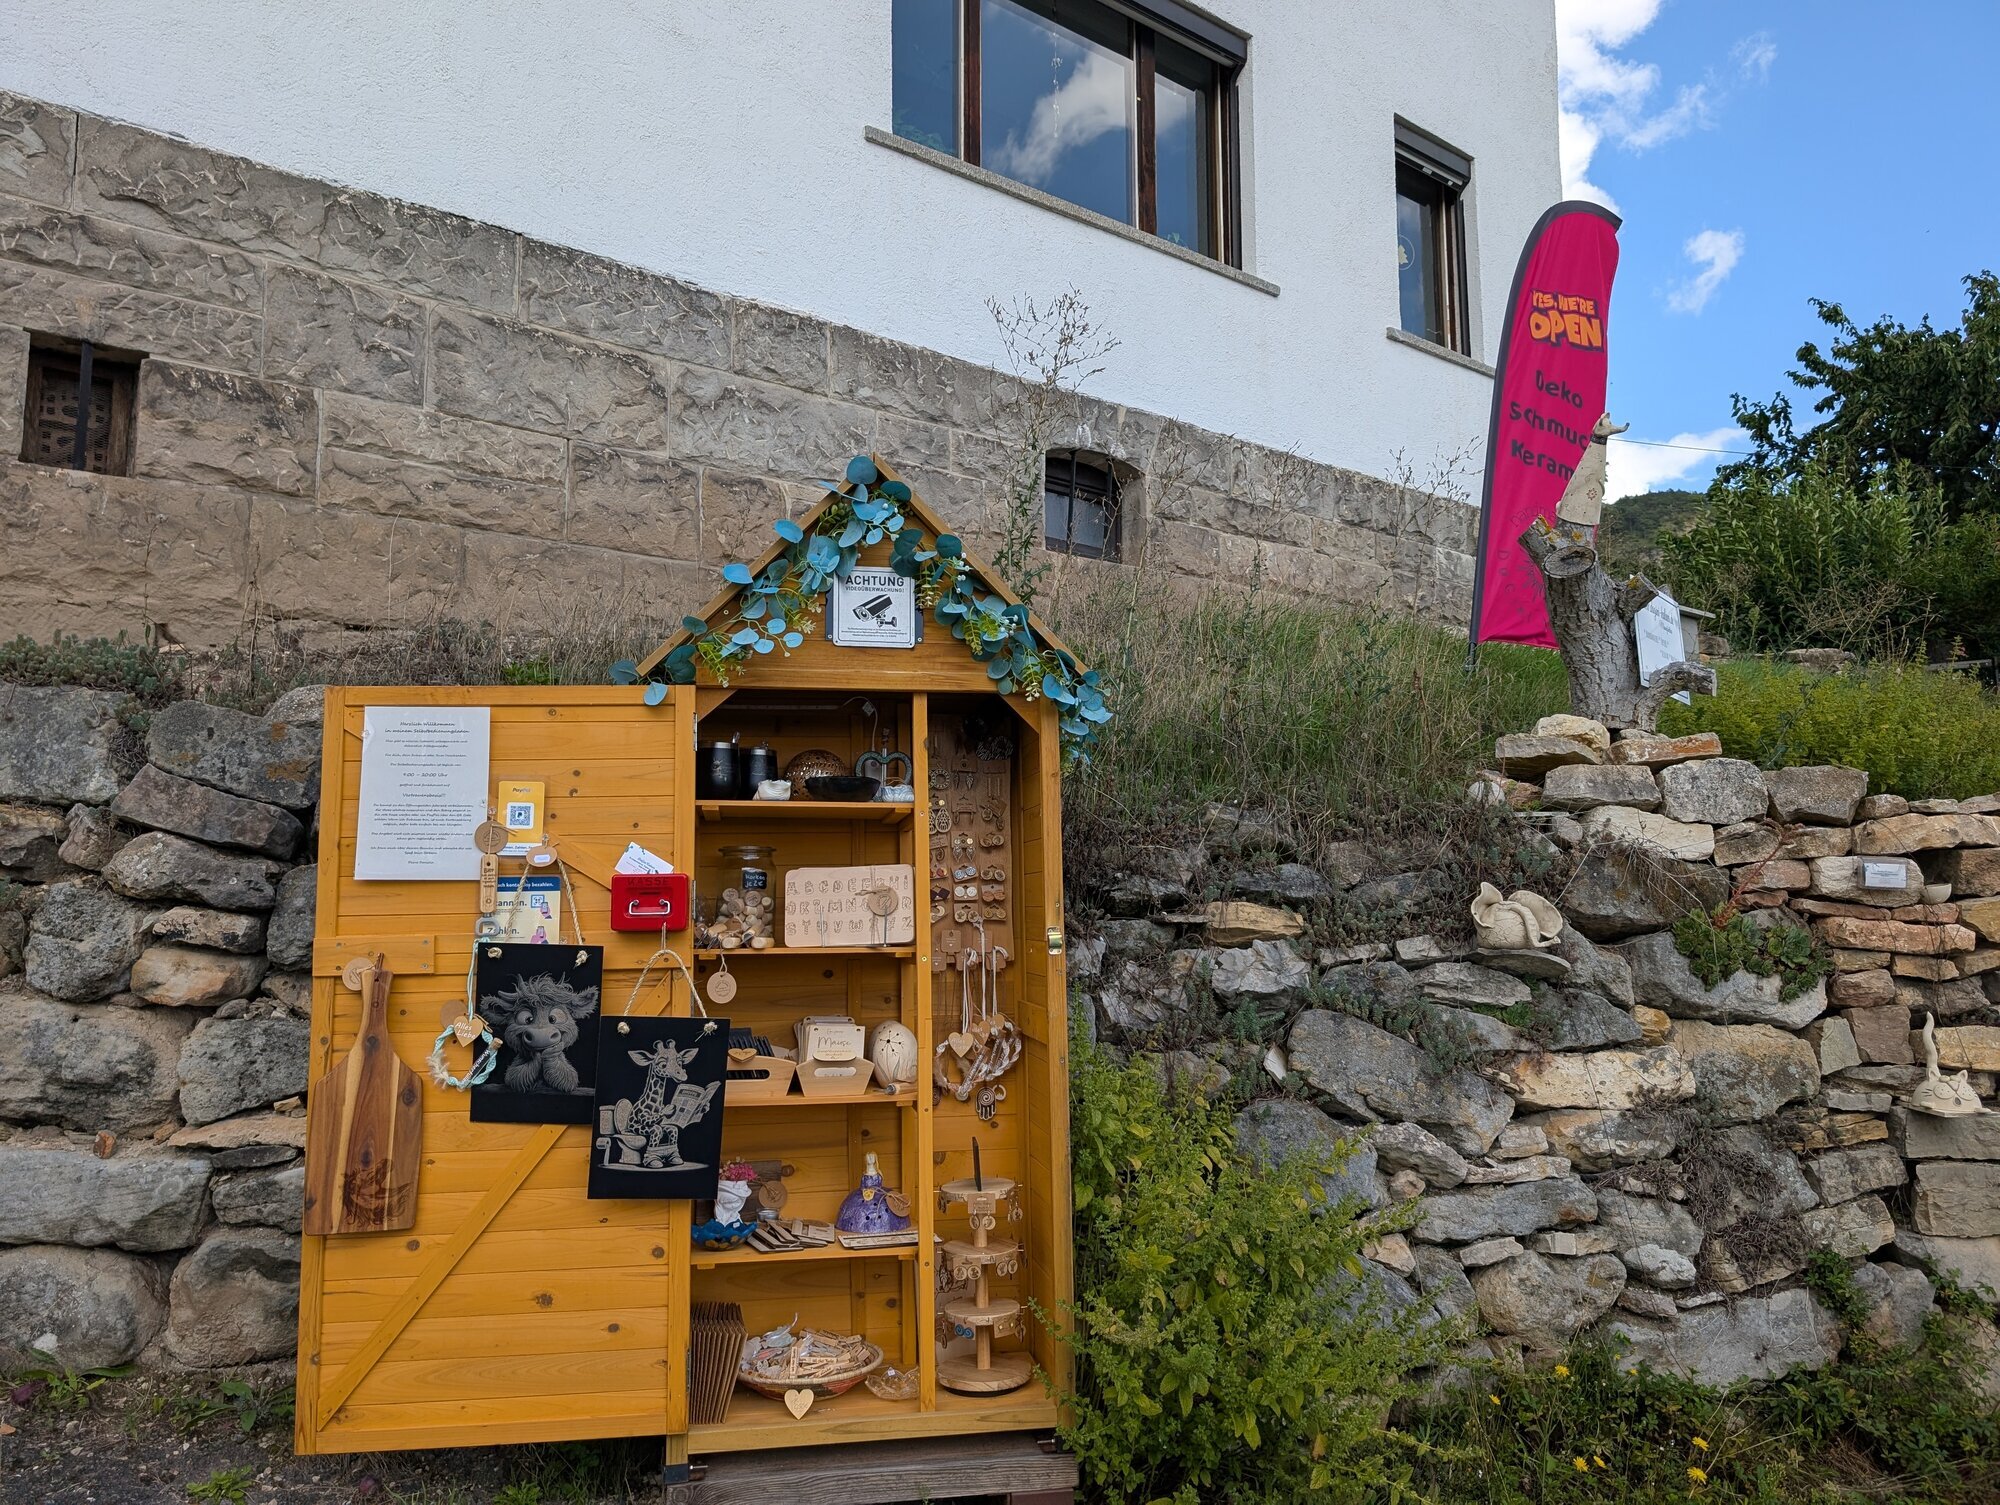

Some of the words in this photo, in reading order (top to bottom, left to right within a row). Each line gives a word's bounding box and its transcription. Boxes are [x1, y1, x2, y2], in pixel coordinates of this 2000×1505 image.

[1532, 290, 1557, 308] YES,
[1557, 294, 1595, 315] WE'RE
[1529, 309, 1603, 348] OPEN
[1535, 369, 1583, 410] Deko
[1509, 401, 1590, 450] Schmuc
[1510, 438, 1575, 481] Keram
[845, 575, 904, 587] ACHTUNG
[626, 877, 670, 887] KASSE
[487, 927, 520, 935] Zhln.
[454, 1022, 473, 1031] Alles
[456, 1029, 476, 1039] Liebe
